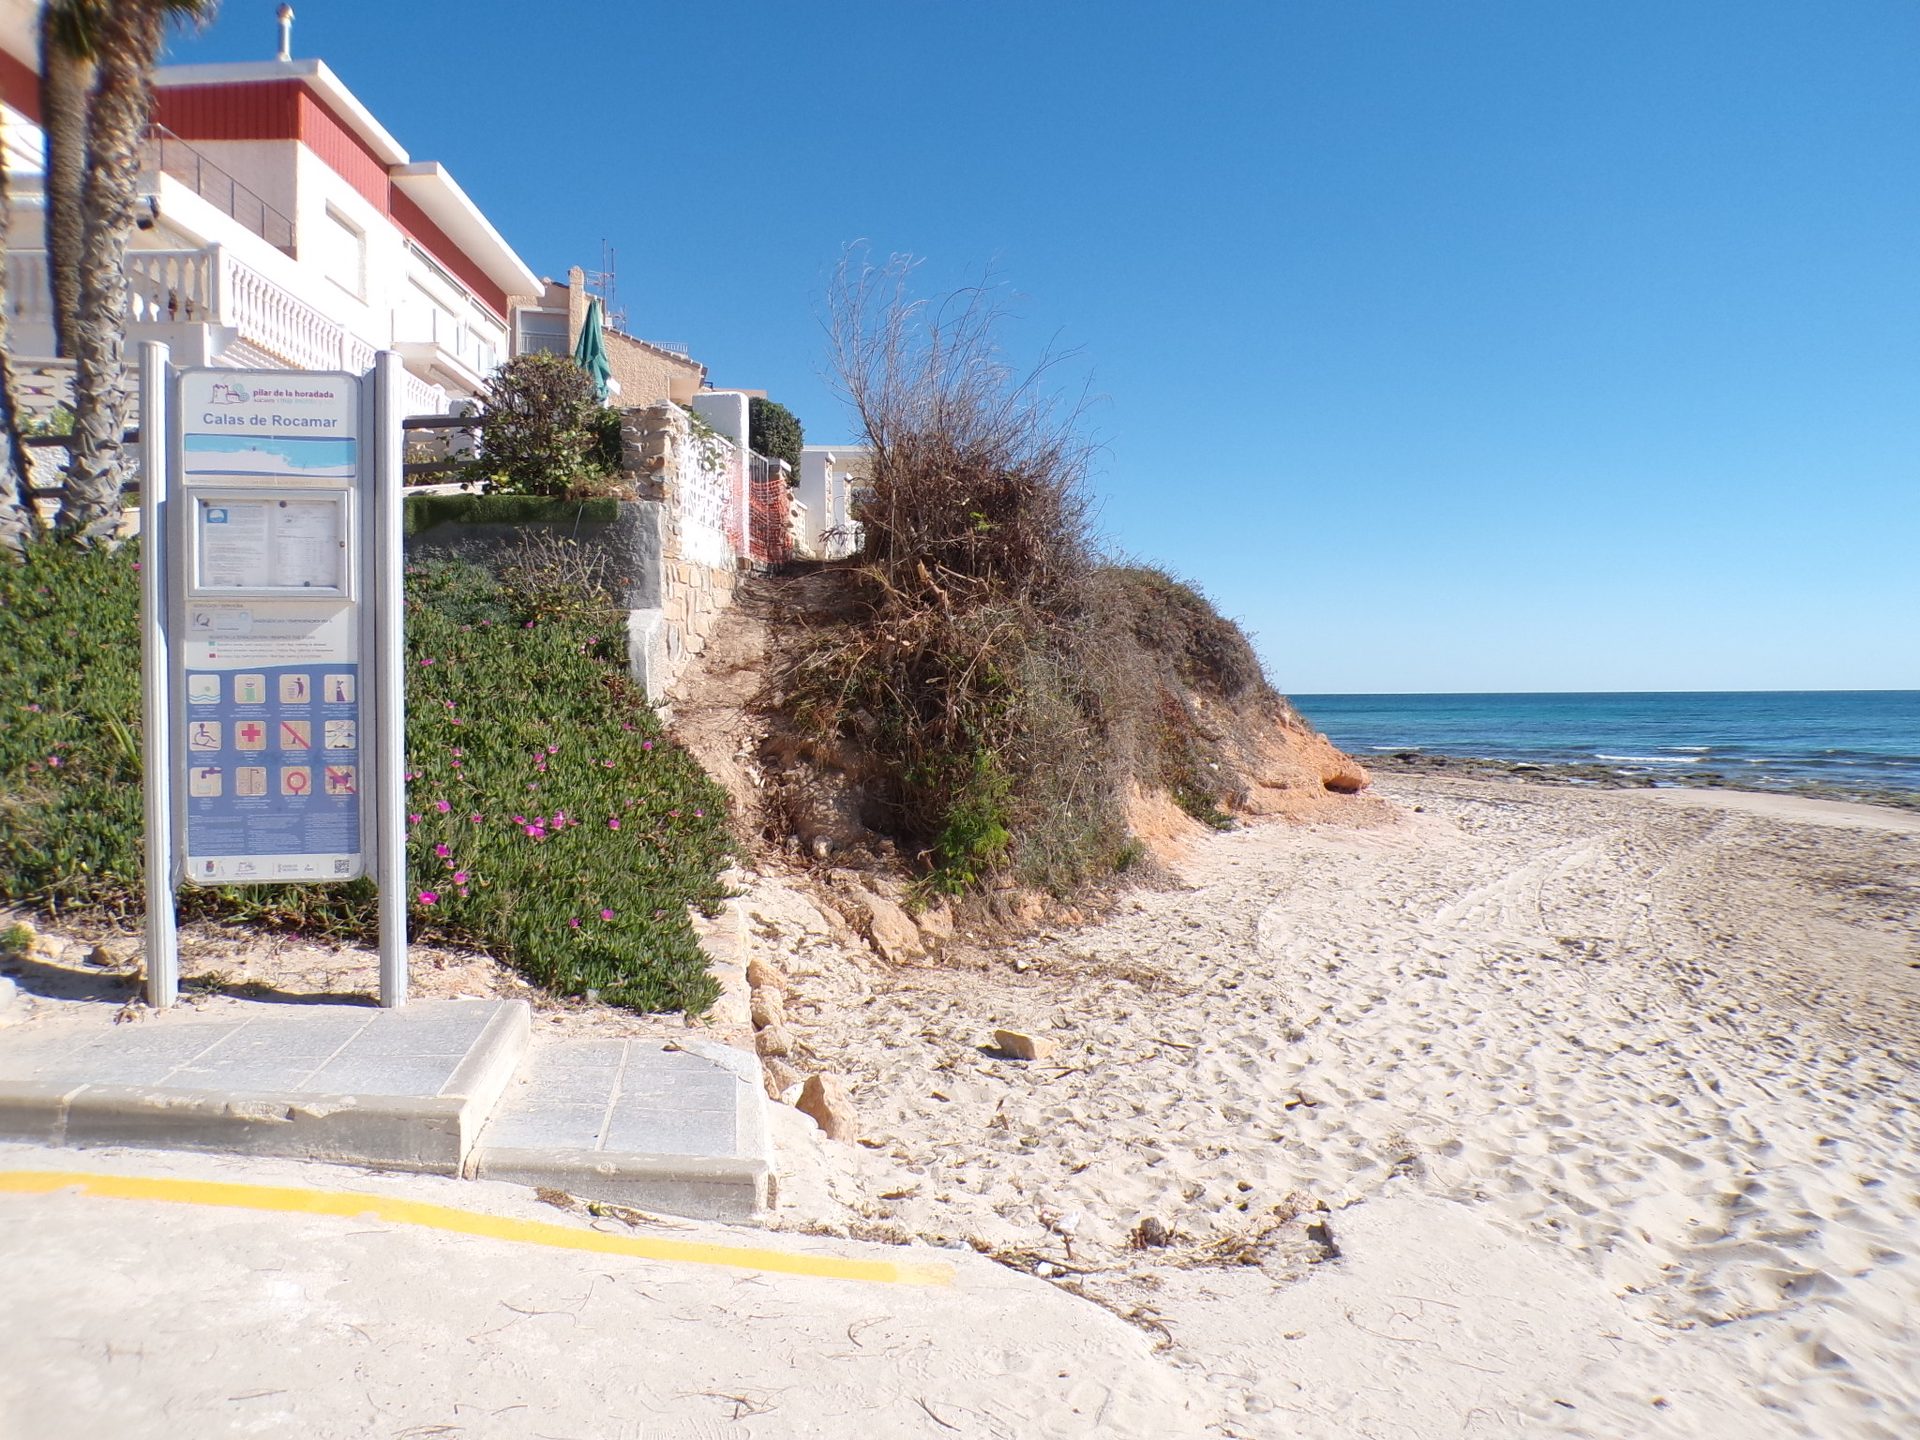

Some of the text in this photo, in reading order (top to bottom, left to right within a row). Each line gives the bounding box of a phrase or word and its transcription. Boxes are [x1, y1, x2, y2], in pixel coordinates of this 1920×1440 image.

[253, 389, 334, 399] pilar de la horadada
[203, 413, 338, 428] Calas de Rocamar
